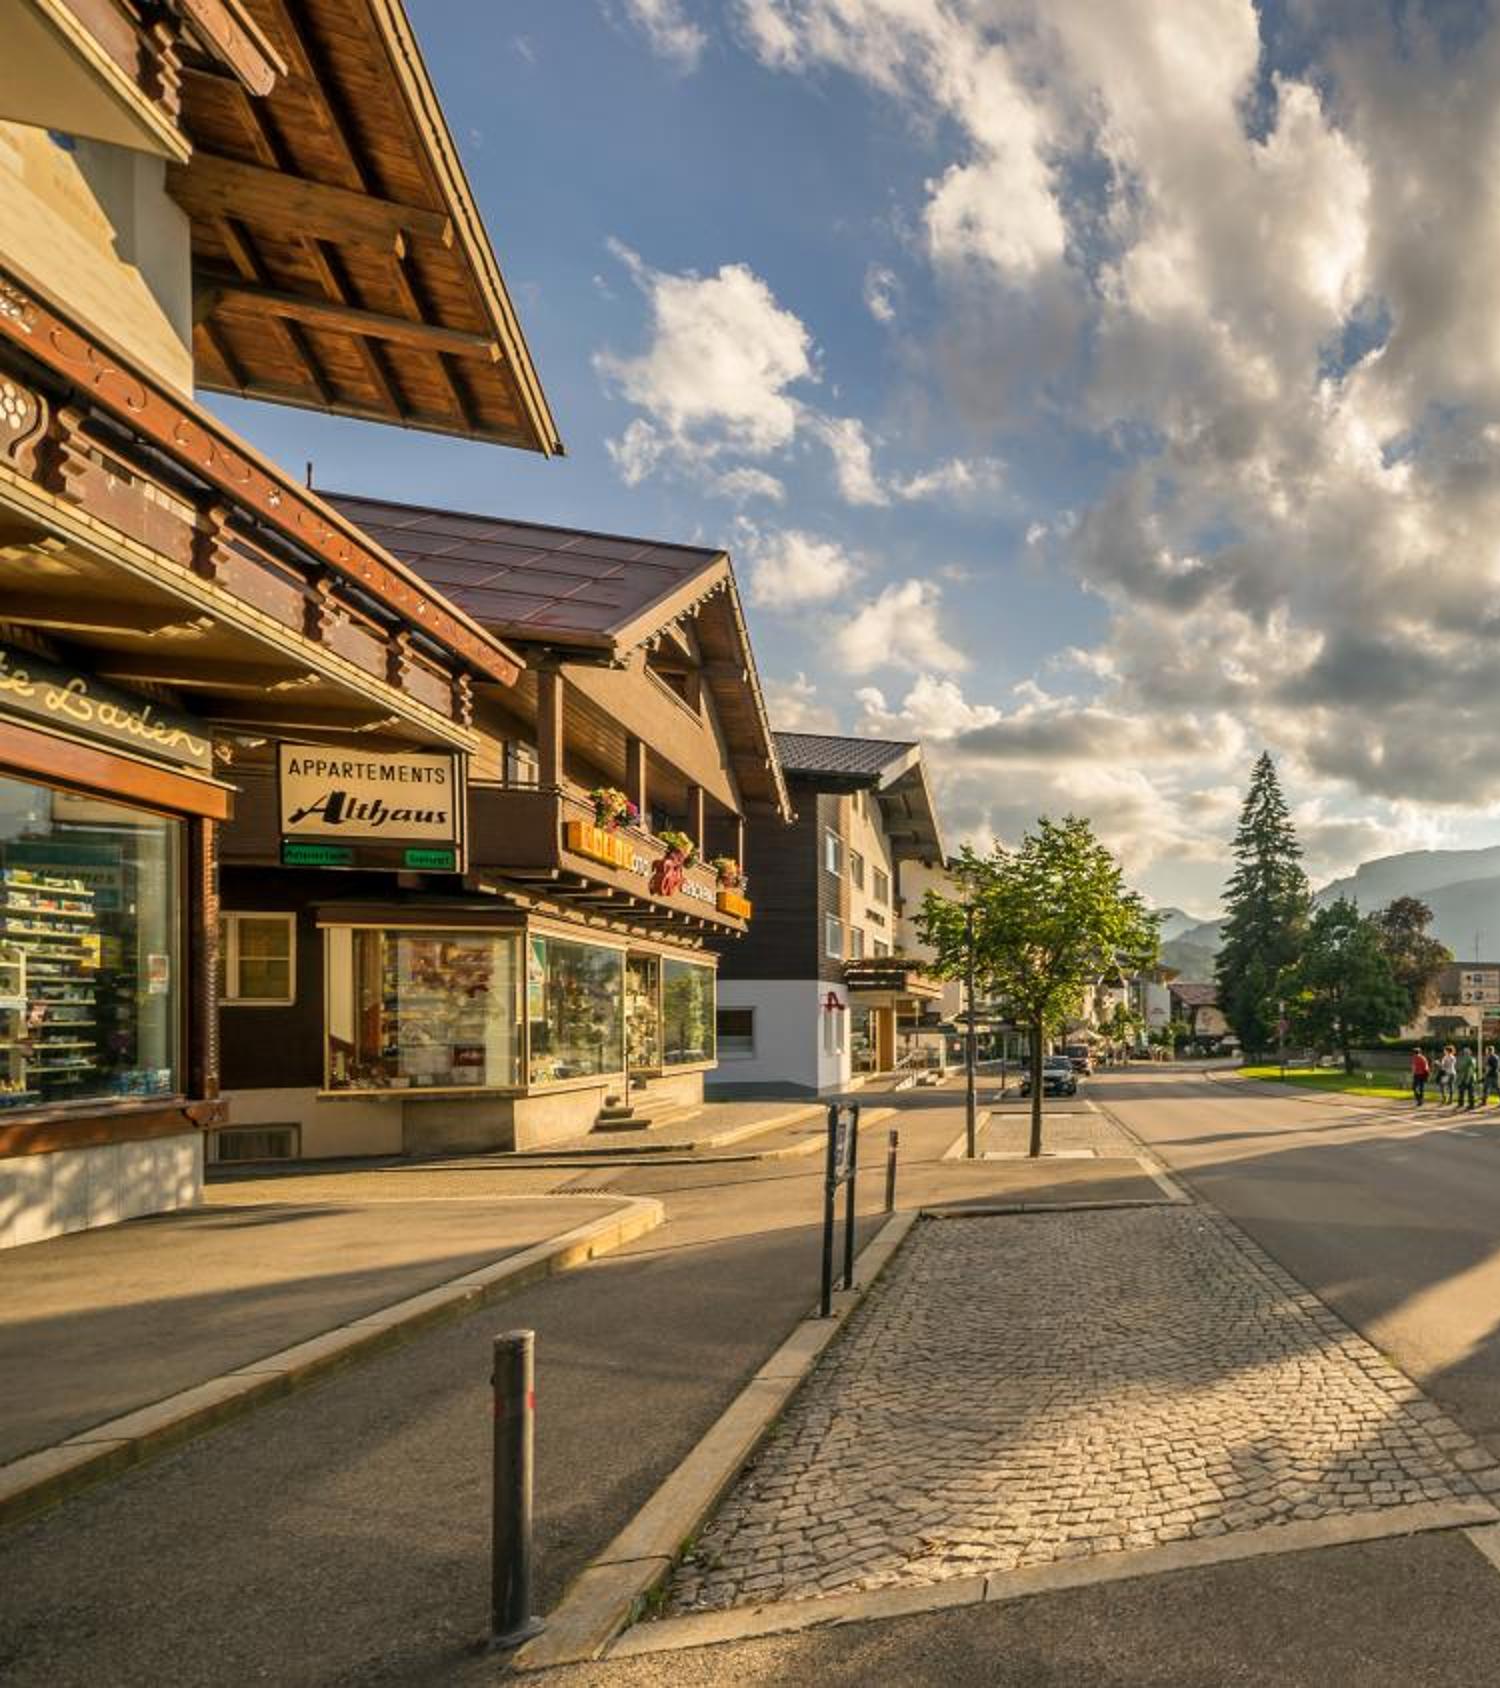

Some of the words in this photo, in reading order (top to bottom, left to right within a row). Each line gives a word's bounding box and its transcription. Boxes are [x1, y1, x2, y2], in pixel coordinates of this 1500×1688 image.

[46, 678, 205, 756] Laden
[288, 758, 446, 785] APPARTEMENTS
[287, 790, 449, 828] Althaus
